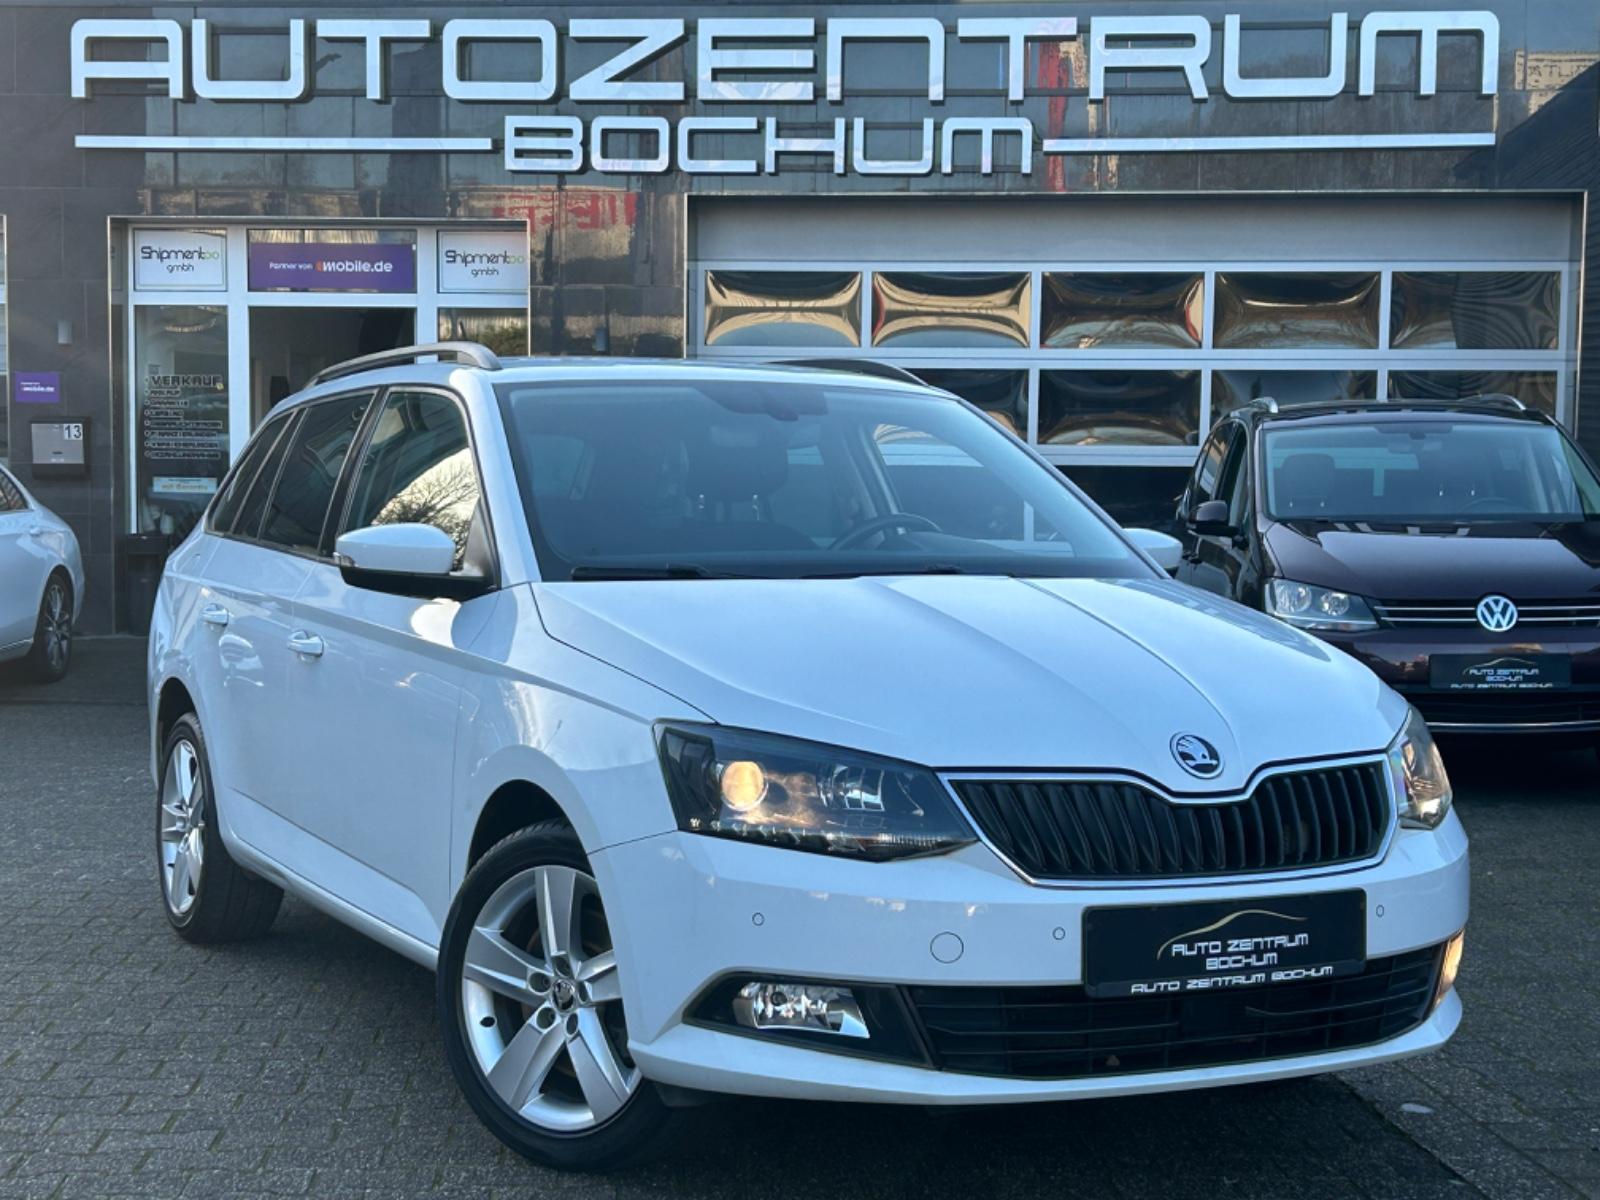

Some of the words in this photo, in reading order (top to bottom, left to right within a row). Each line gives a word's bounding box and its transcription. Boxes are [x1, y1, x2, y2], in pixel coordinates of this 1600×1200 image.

[70, 10, 1500, 102] AUTOZENTRUM
[504, 115, 1033, 175] BOCHUM
[151, 375, 223, 388] VERKAUF
[64, 424, 82, 440] 13
[1172, 941, 1221, 957] AUTO
[1227, 933, 1309, 952] ZENTRUM
[1206, 952, 1278, 970] BOCHUM
[1131, 981, 1180, 994] AUTO
[1186, 972, 1266, 990] ZENTRUM
[1271, 966, 1333, 981] BOCHUM
